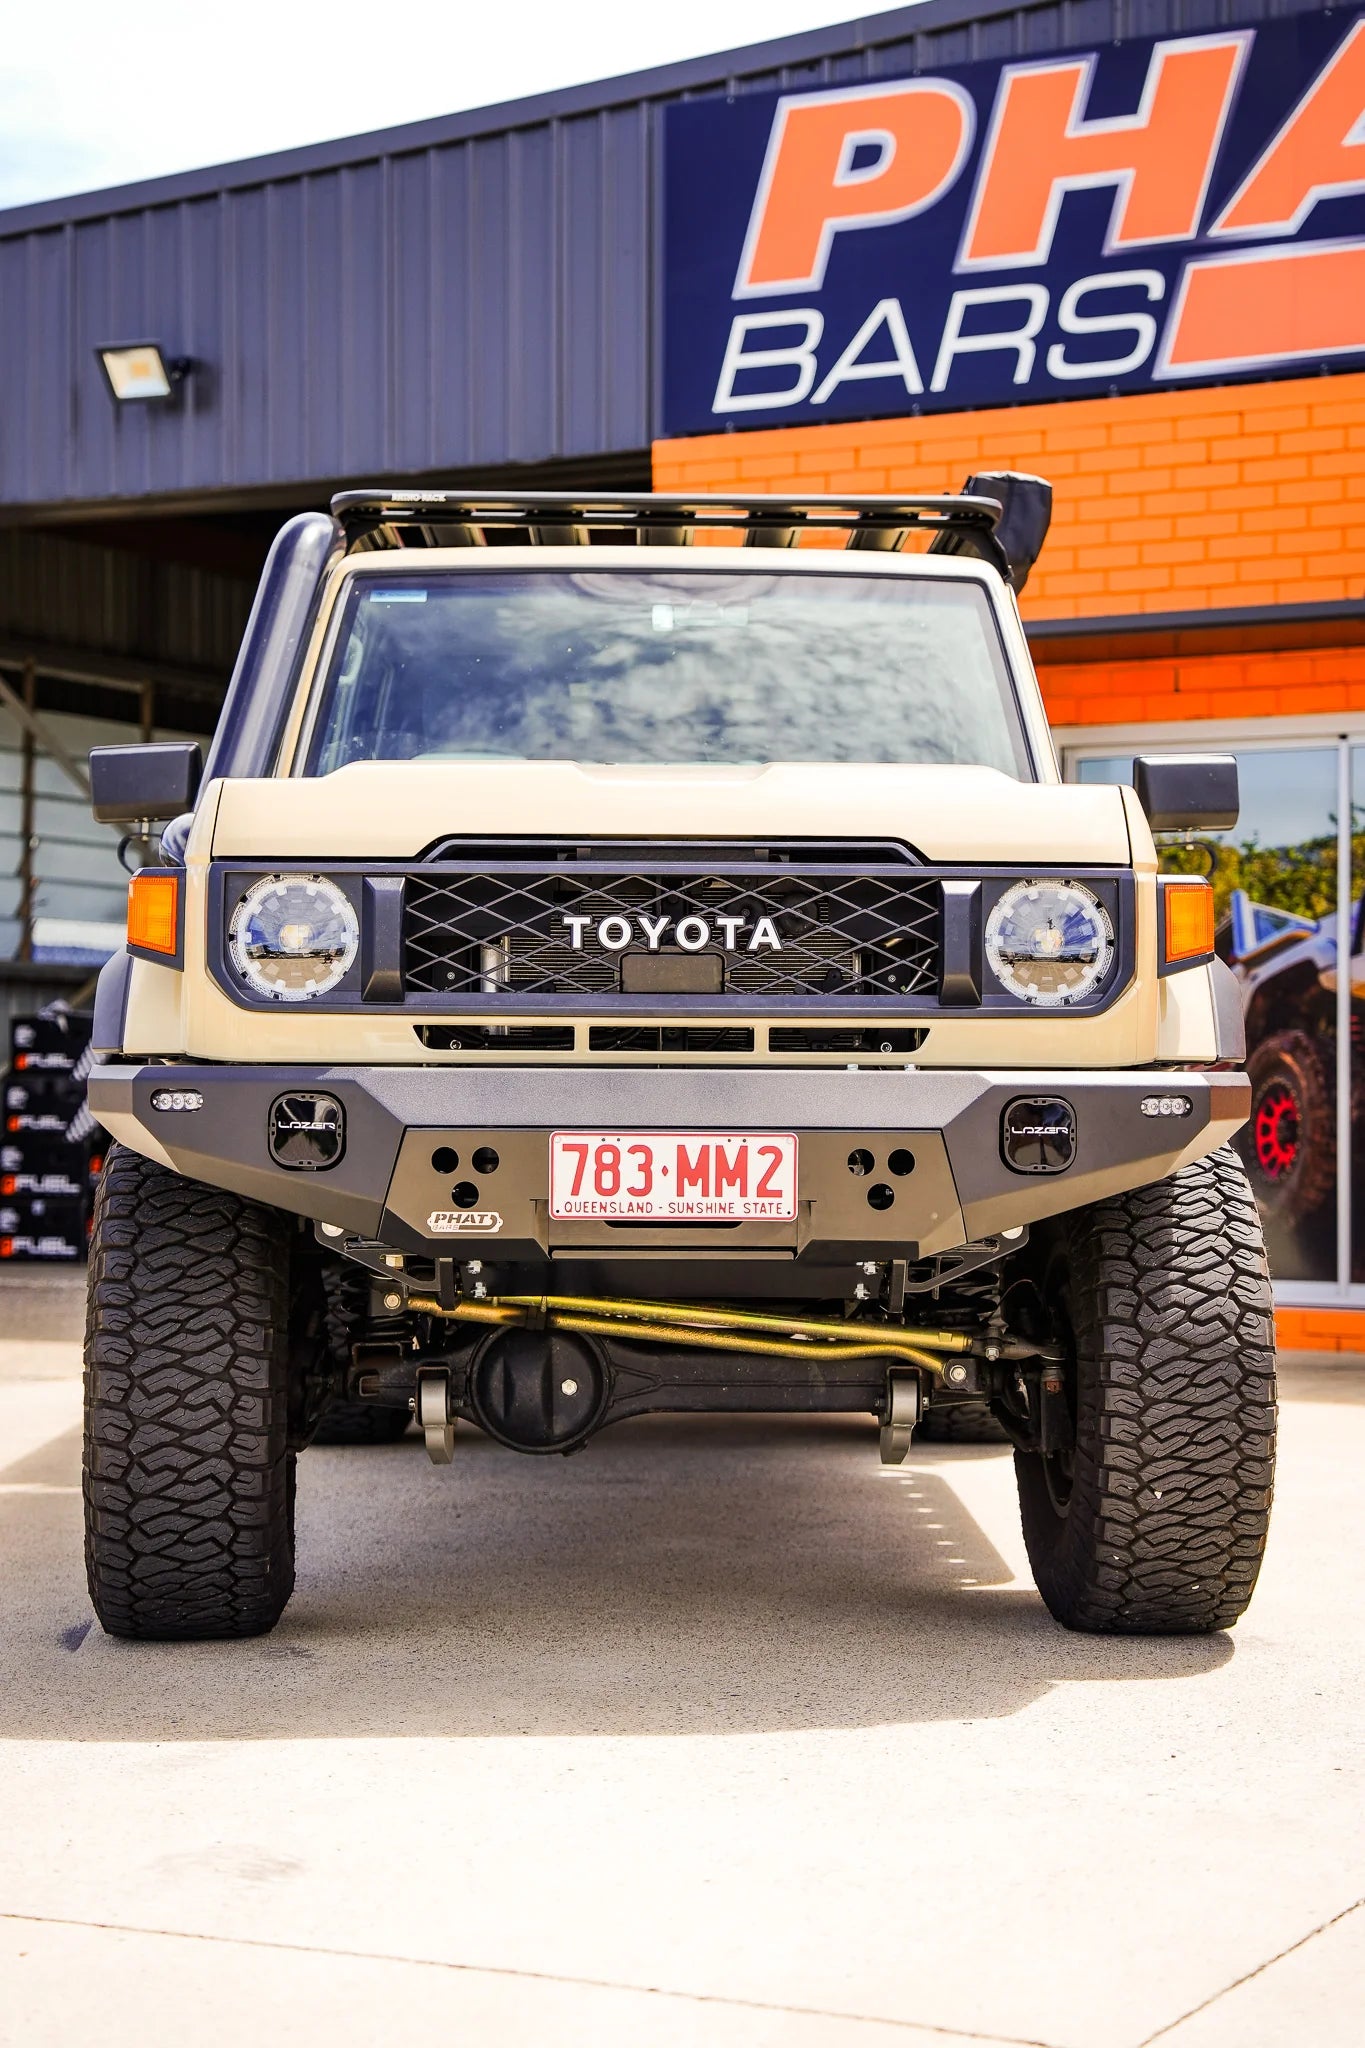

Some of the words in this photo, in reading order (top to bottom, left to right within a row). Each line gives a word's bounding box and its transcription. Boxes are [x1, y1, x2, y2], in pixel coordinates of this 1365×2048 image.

[711, 268, 1166, 413] BARS
[562, 915, 784, 952] TOYOTA
[278, 1120, 336, 1130] LAZER
[1011, 1126, 1069, 1135] LAZER
[564, 1201, 653, 1213] QUEENSLAND
[668, 1202, 735, 1214] SUNSHINE
[743, 1202, 783, 1214] STATE
[434, 1213, 489, 1224] PHAT
